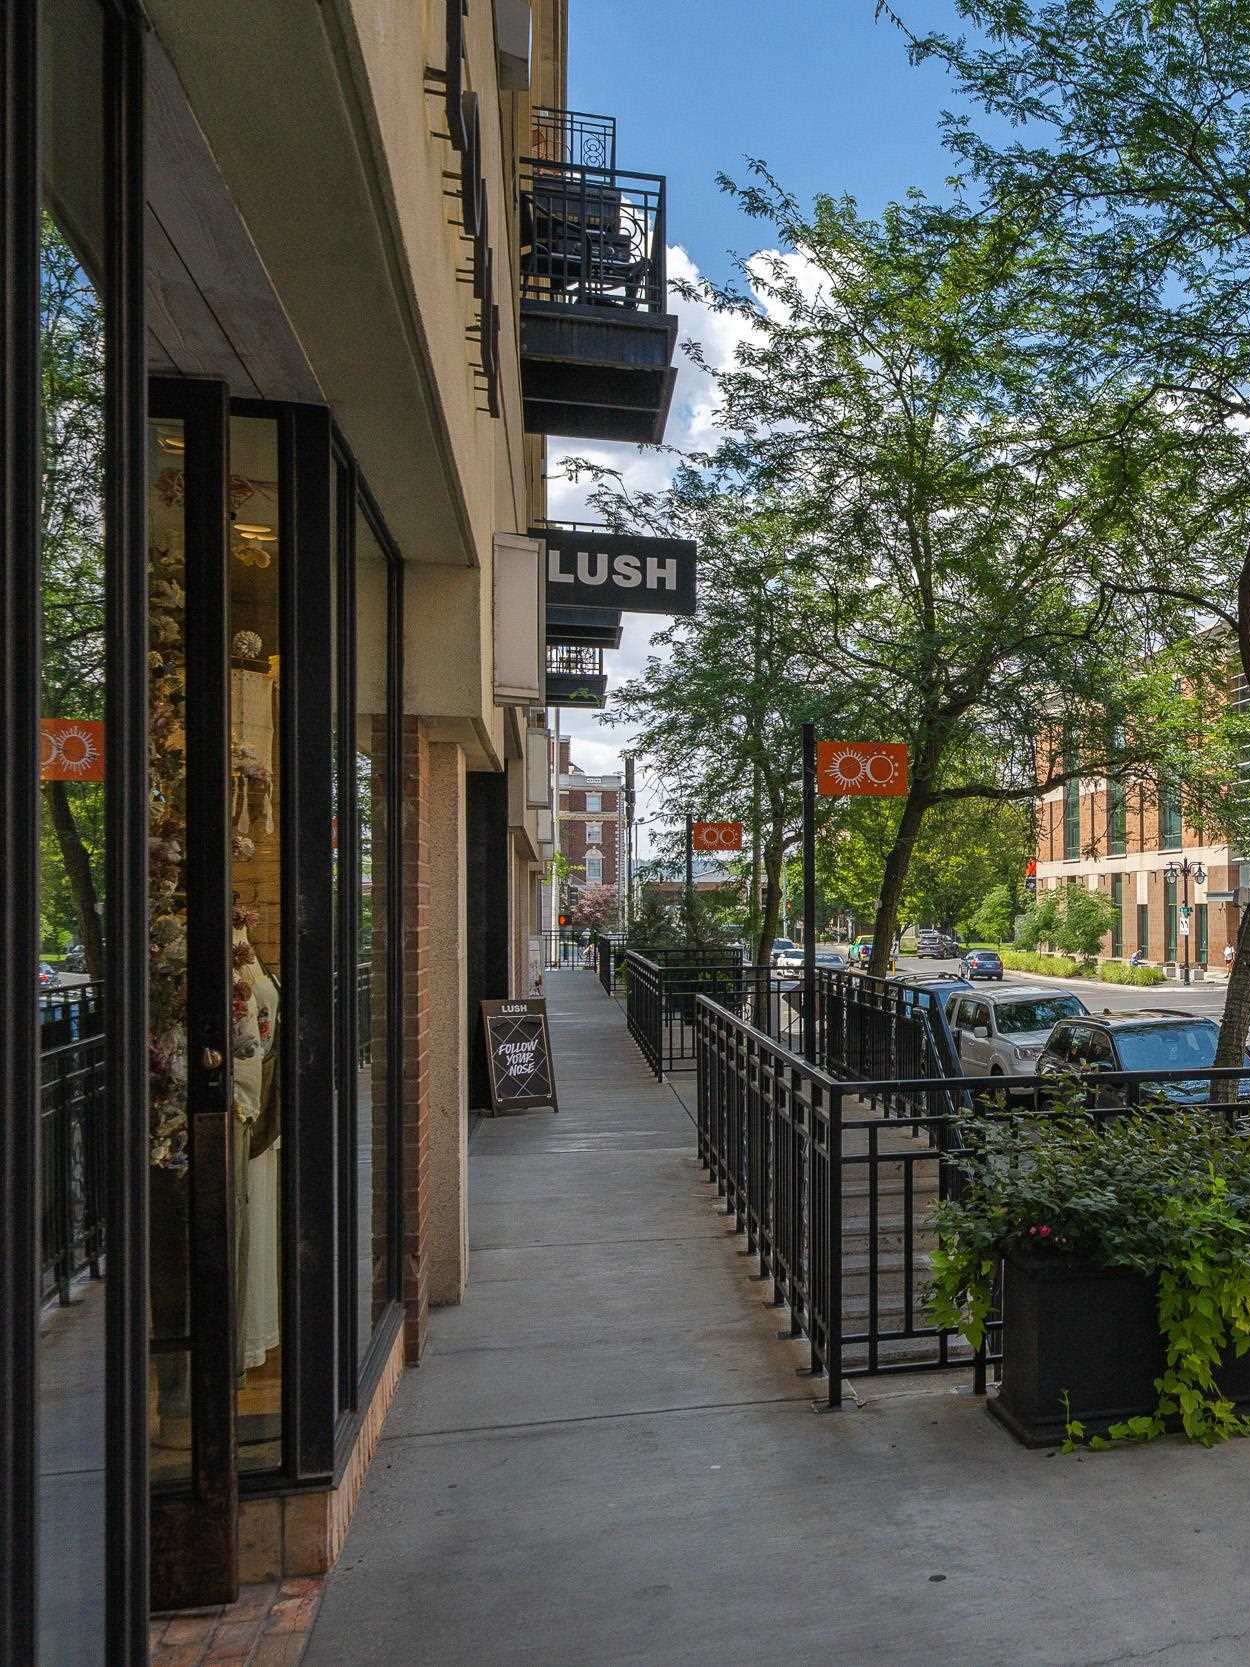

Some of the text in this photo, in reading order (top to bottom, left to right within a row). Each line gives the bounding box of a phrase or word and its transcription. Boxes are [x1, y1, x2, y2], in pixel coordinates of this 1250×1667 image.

[548, 549, 677, 591] LUSH
[501, 1004, 528, 1013] LUSH
[497, 1040, 538, 1055] FOLLOW
[506, 1052, 535, 1066] YOUR
[509, 1061, 536, 1076] NOSE
